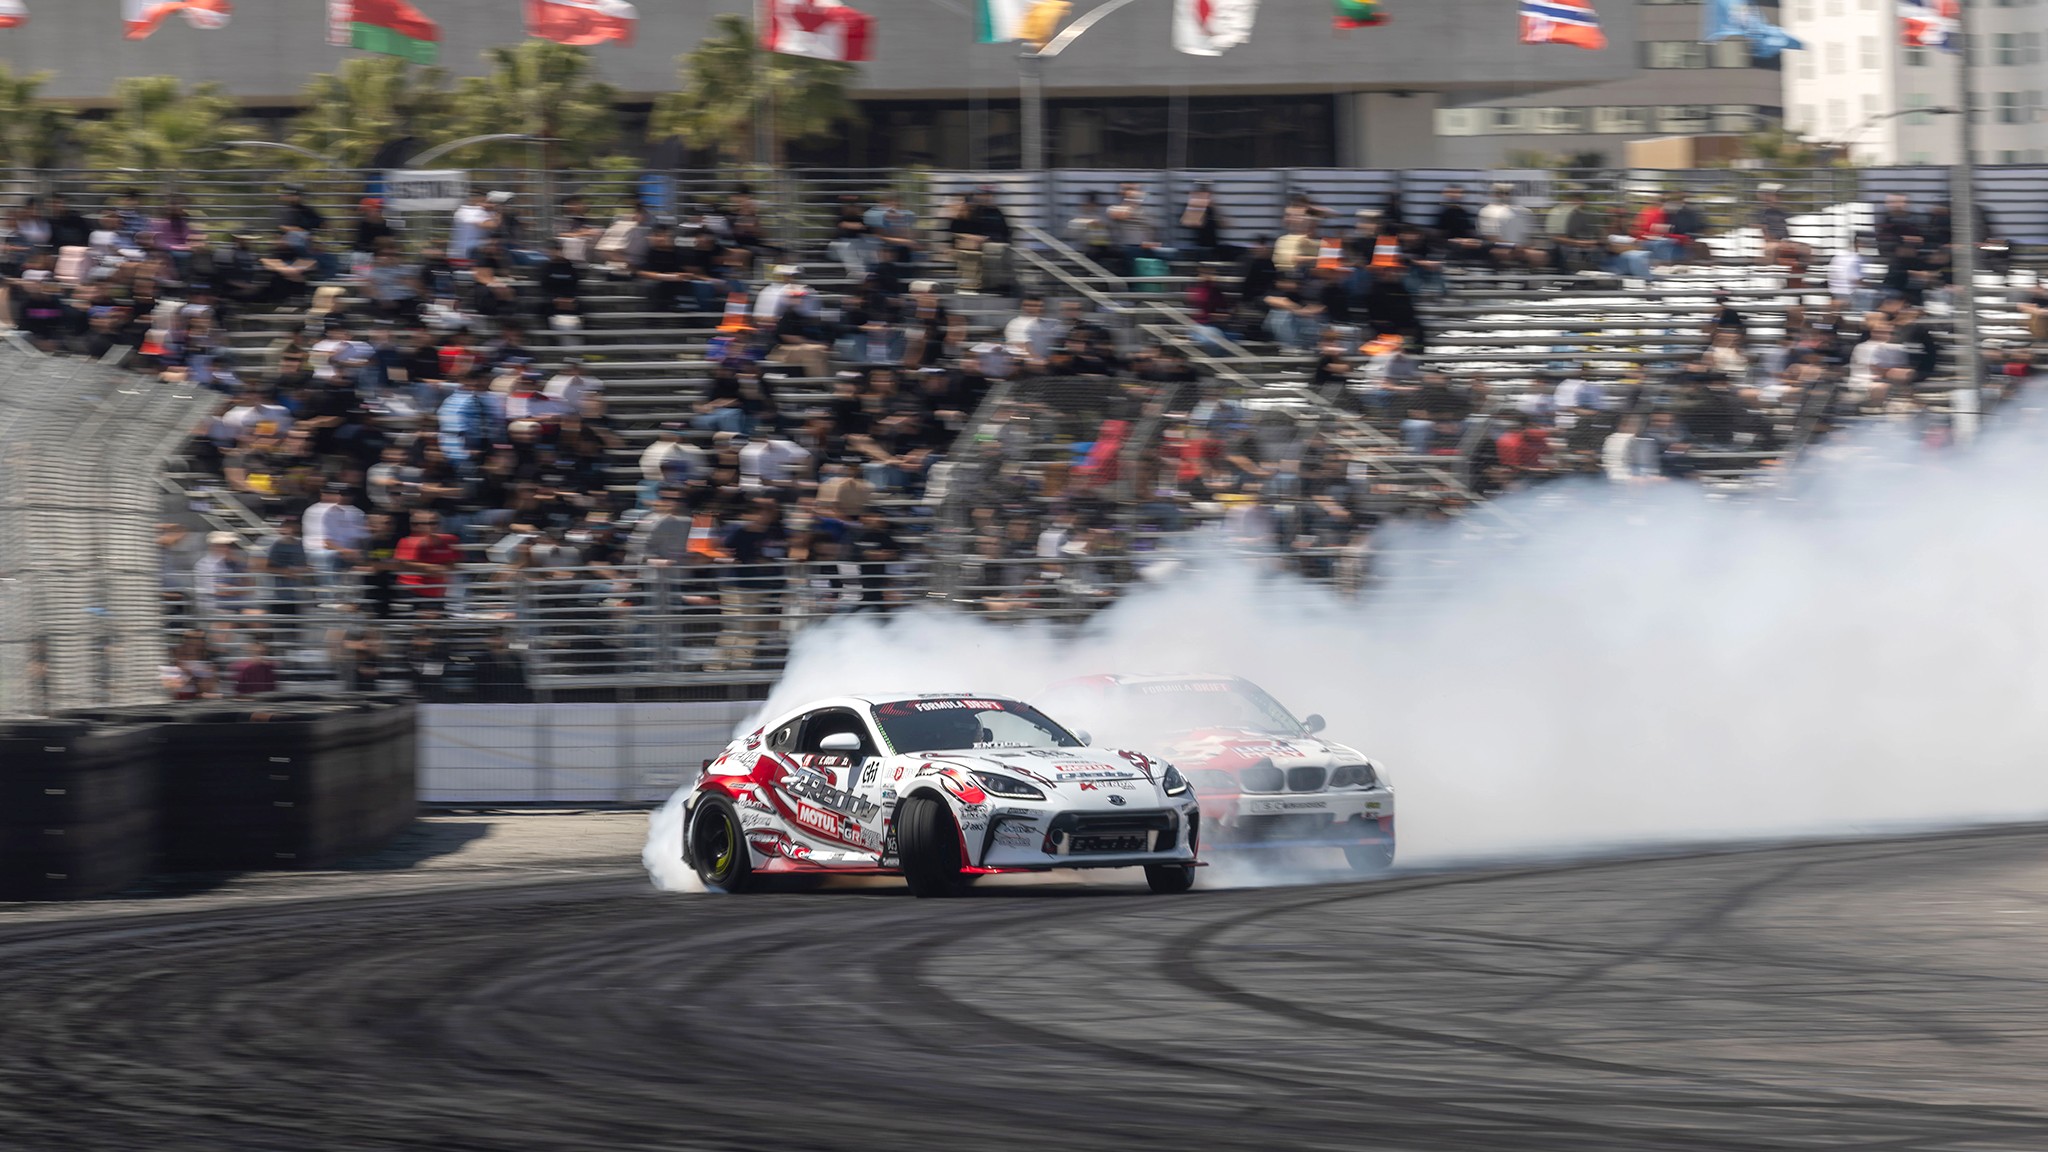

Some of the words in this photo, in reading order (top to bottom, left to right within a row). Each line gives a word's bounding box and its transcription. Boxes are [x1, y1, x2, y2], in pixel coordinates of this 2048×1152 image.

[1143, 684, 1192, 695] FORMULA
[1194, 682, 1229, 692] DRIFT
[915, 701, 965, 712] FORMULA
[966, 700, 999, 711] DRIFT
[800, 805, 837, 834] MOTUL
[844, 827, 861, 843] GR
